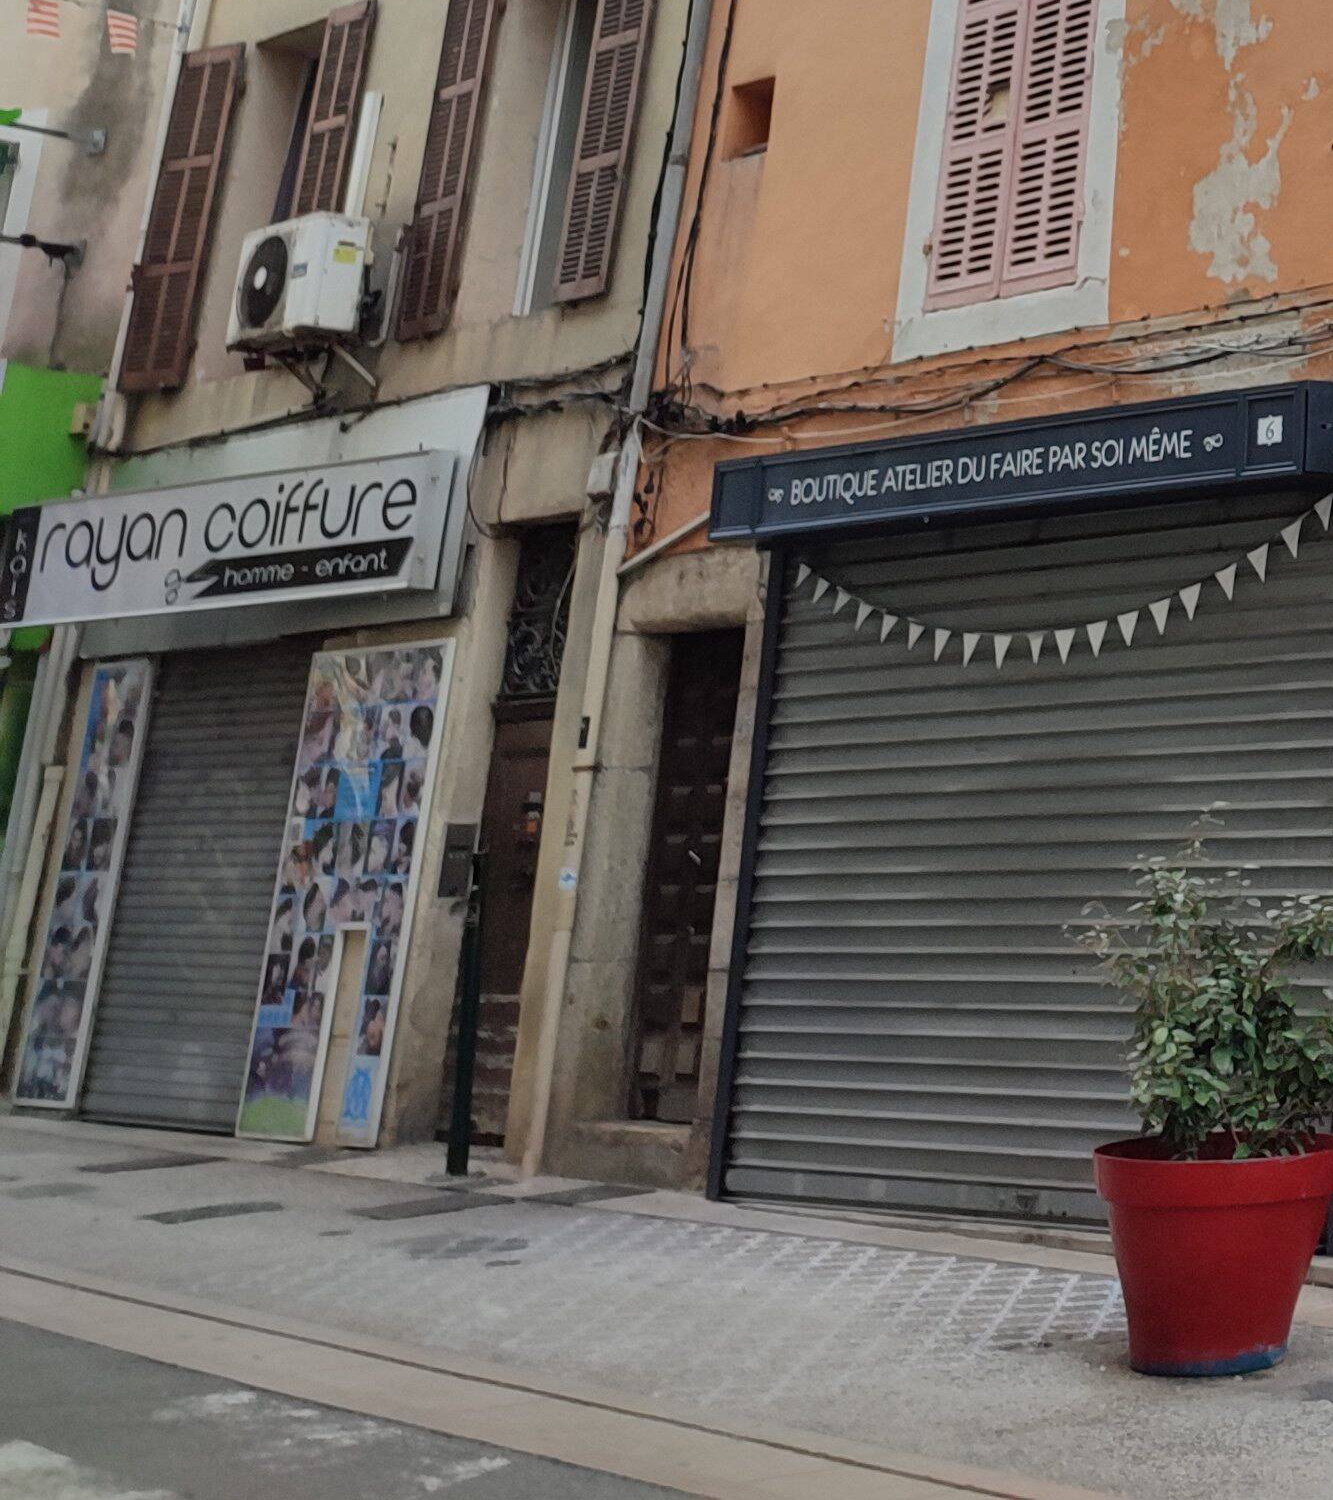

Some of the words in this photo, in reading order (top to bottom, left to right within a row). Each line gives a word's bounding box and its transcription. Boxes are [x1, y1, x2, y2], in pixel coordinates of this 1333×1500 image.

[1265, 419, 1275, 440] 6
[790, 468, 879, 505] BOUTIQUE
[881, 459, 954, 494] ATELIER
[957, 454, 986, 484] DU
[989, 447, 1045, 481] FAIRE
[1048, 442, 1087, 473] PAR
[1090, 438, 1124, 469] SOI
[1128, 426, 1193, 465] MÊME
[40, 508, 188, 591] rayan
[203, 478, 418, 553] coiffure
[223, 563, 295, 588] homme
[315, 548, 388, 577] enfant
